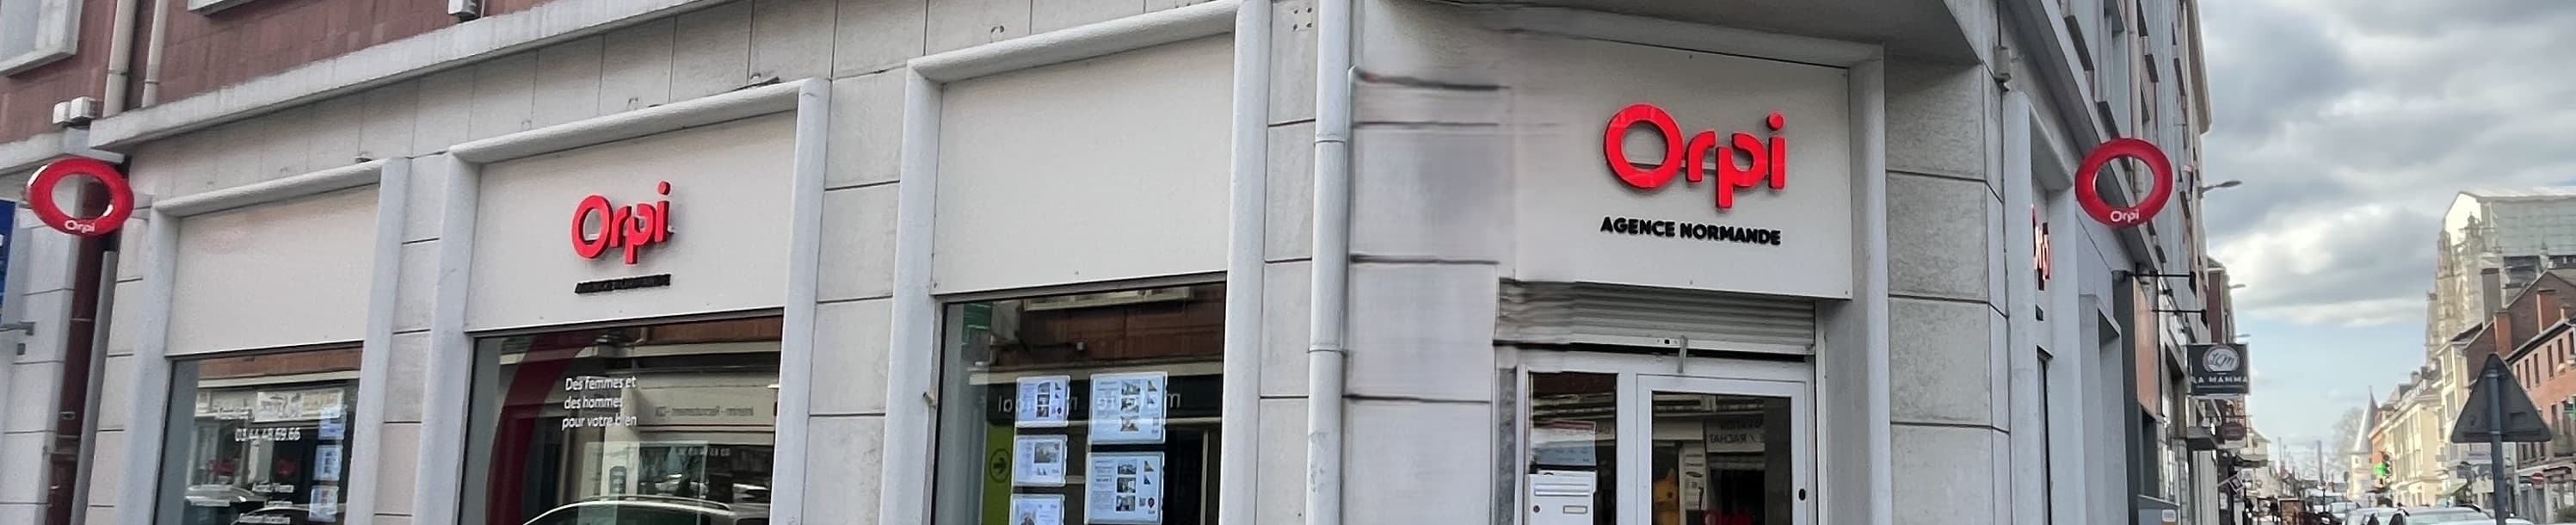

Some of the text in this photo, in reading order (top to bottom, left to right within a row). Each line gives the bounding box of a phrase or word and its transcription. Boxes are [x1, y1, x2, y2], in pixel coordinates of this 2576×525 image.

[1603, 102, 1787, 209] Orpi
[571, 180, 671, 265] Orpi
[2111, 209, 2140, 223] Orpi
[65, 219, 96, 233] Orpi
[1600, 216, 1781, 246] AGENCE NORMANDE
[565, 375, 637, 391] Des femmes et
[2209, 375, 2248, 384] MAMMA
[564, 395, 622, 409] des hommes
[562, 417, 585, 431] pour
[587, 416, 613, 428] votre
